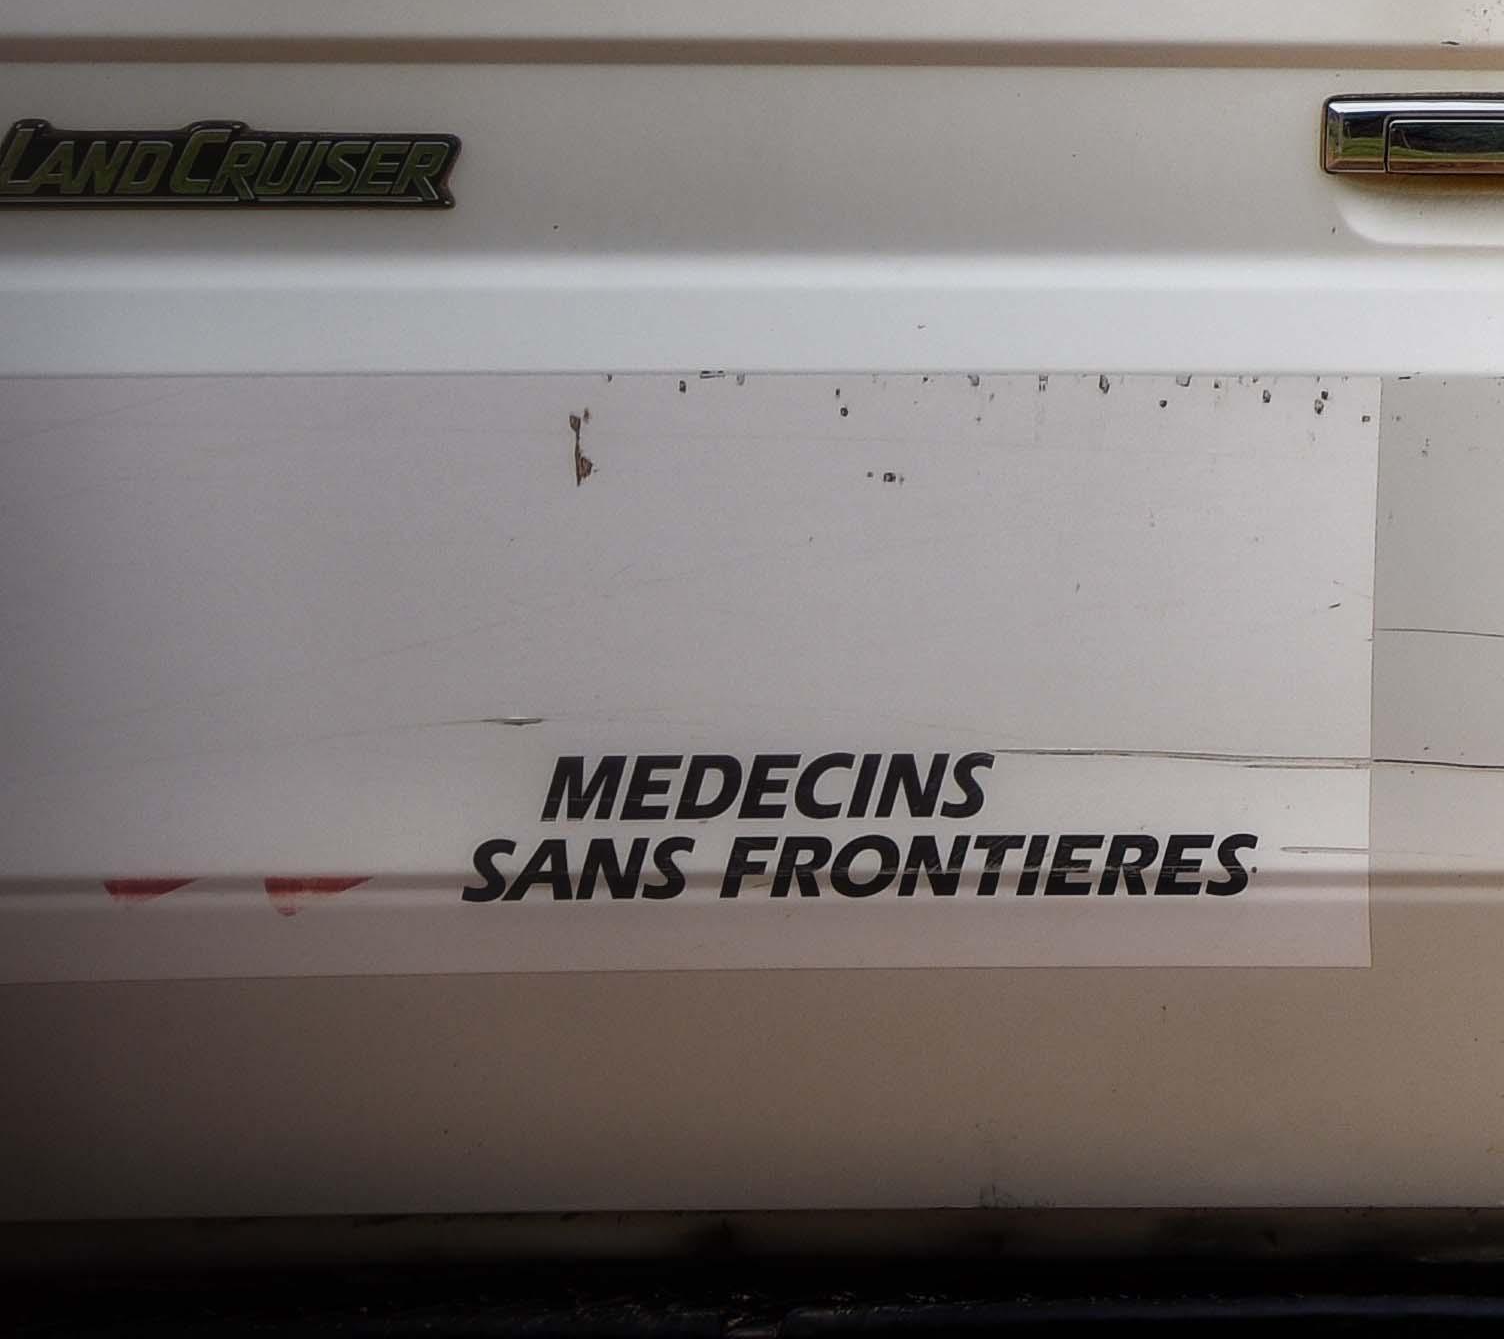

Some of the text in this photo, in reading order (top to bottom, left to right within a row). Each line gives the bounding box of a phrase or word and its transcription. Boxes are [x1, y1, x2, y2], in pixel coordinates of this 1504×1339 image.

[541, 753, 995, 820] MEDECINS
[463, 834, 1255, 901] SANS FRONTIERES
